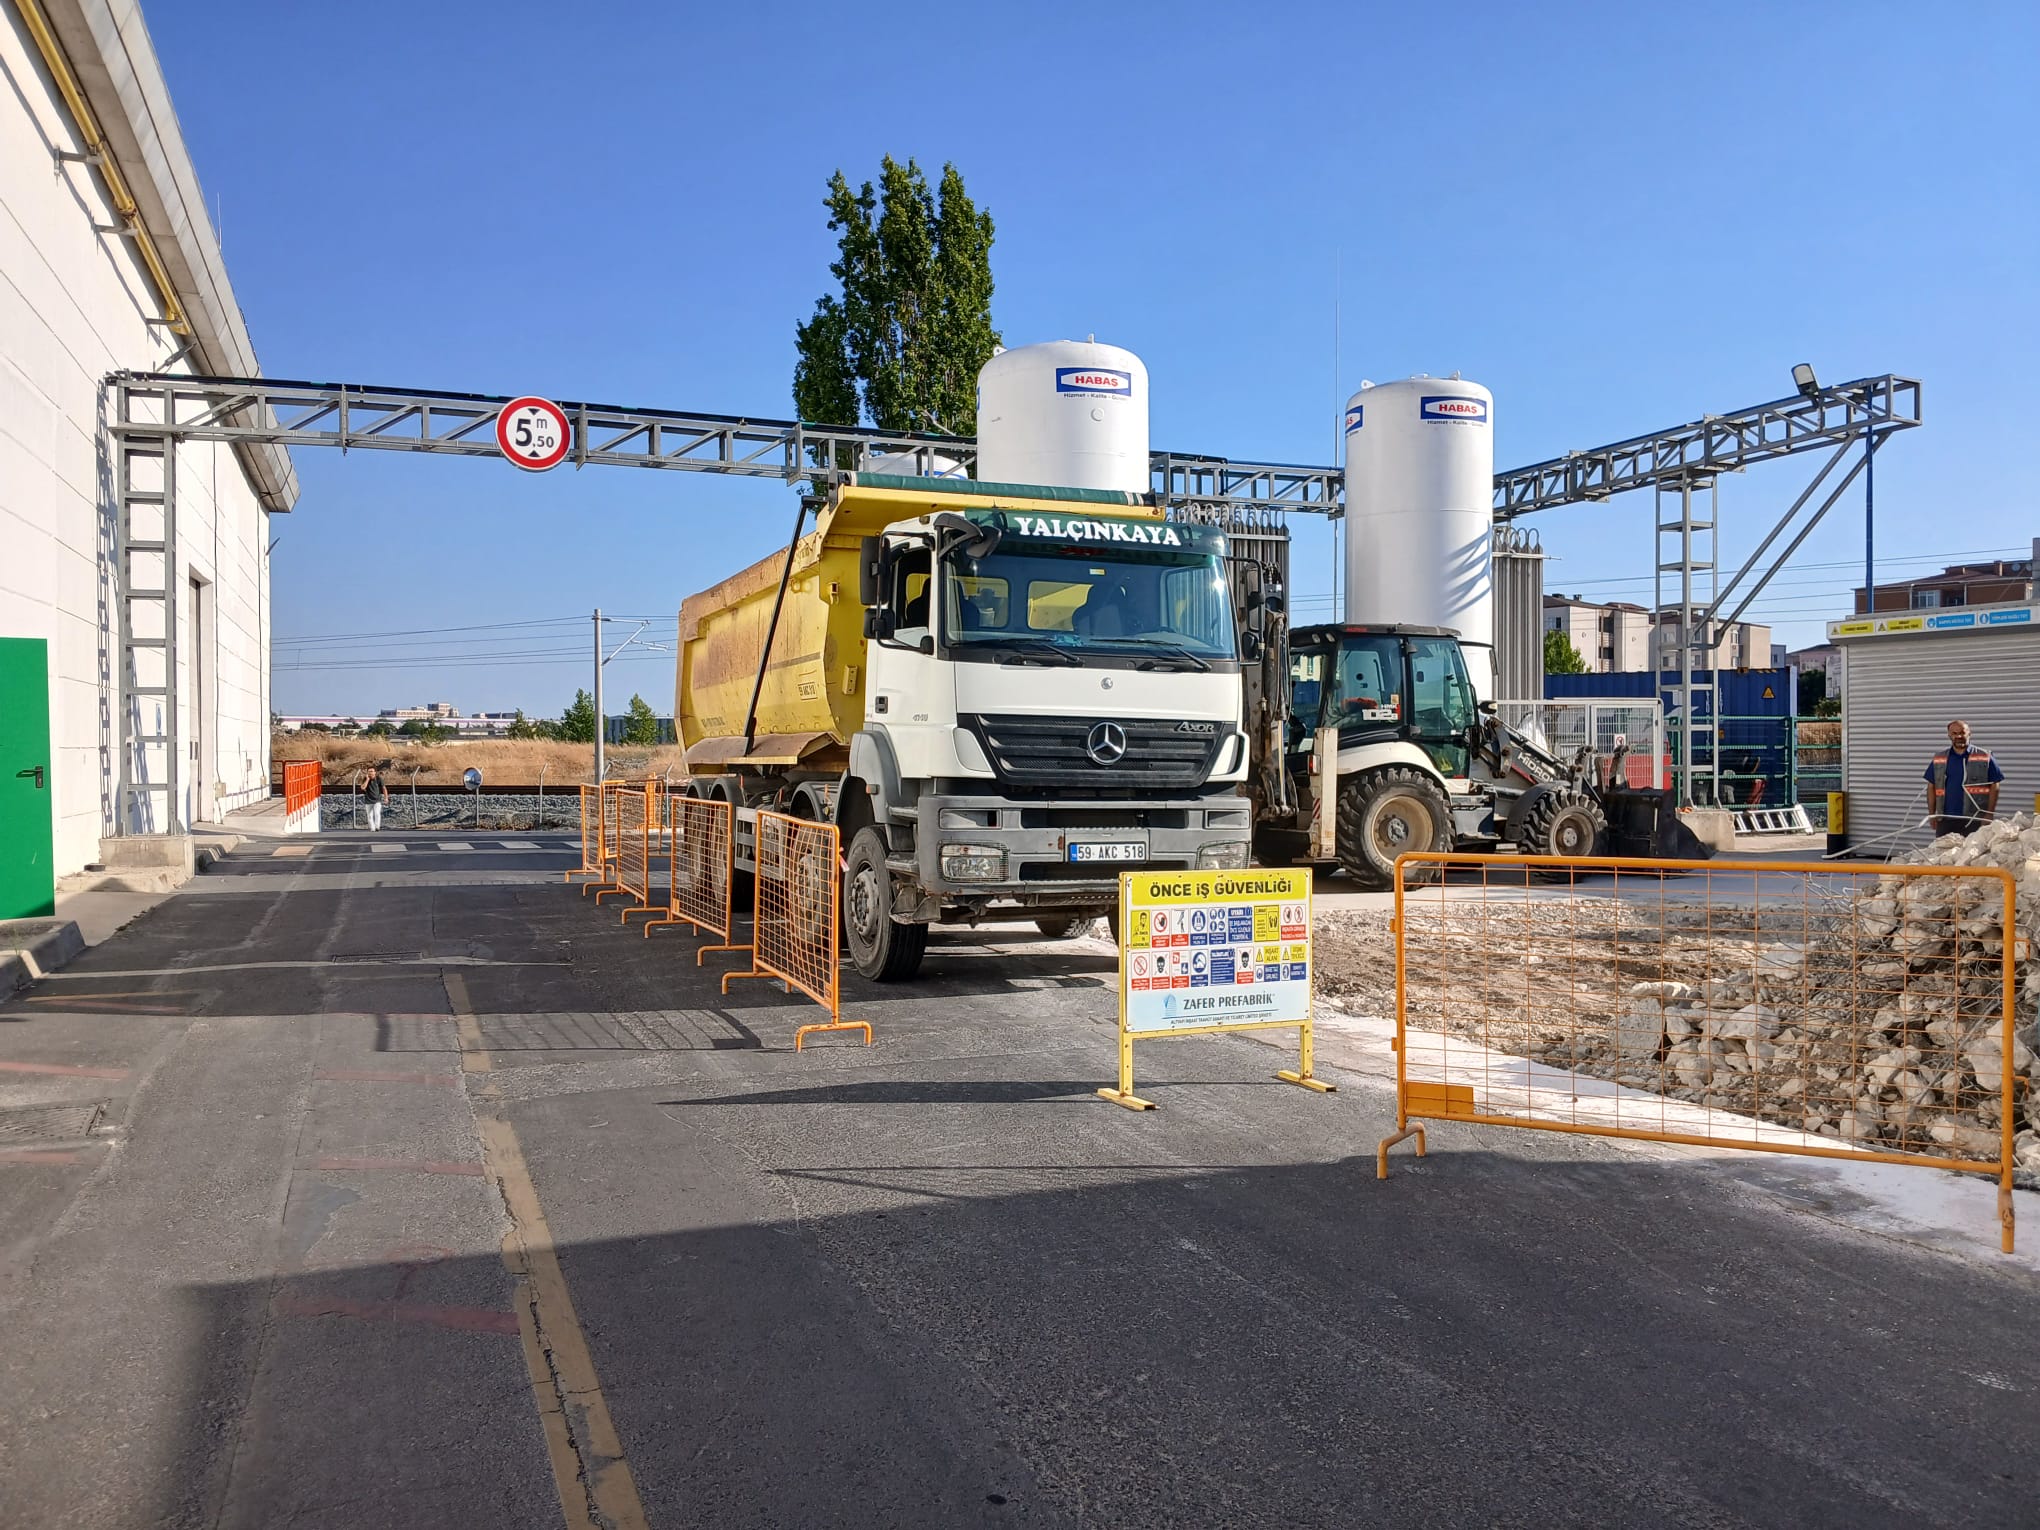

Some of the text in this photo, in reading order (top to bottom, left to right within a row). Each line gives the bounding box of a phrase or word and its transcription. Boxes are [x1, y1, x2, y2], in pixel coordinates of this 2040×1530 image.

[1014, 517, 1182, 546] YALÇINKAYA
[1078, 846, 1092, 859] 59
[1098, 846, 1118, 859] AKC
[1125, 845, 1144, 858] 518
[1150, 882, 1192, 897] ÖNCE
[1183, 997, 1215, 1010] ZAFER
